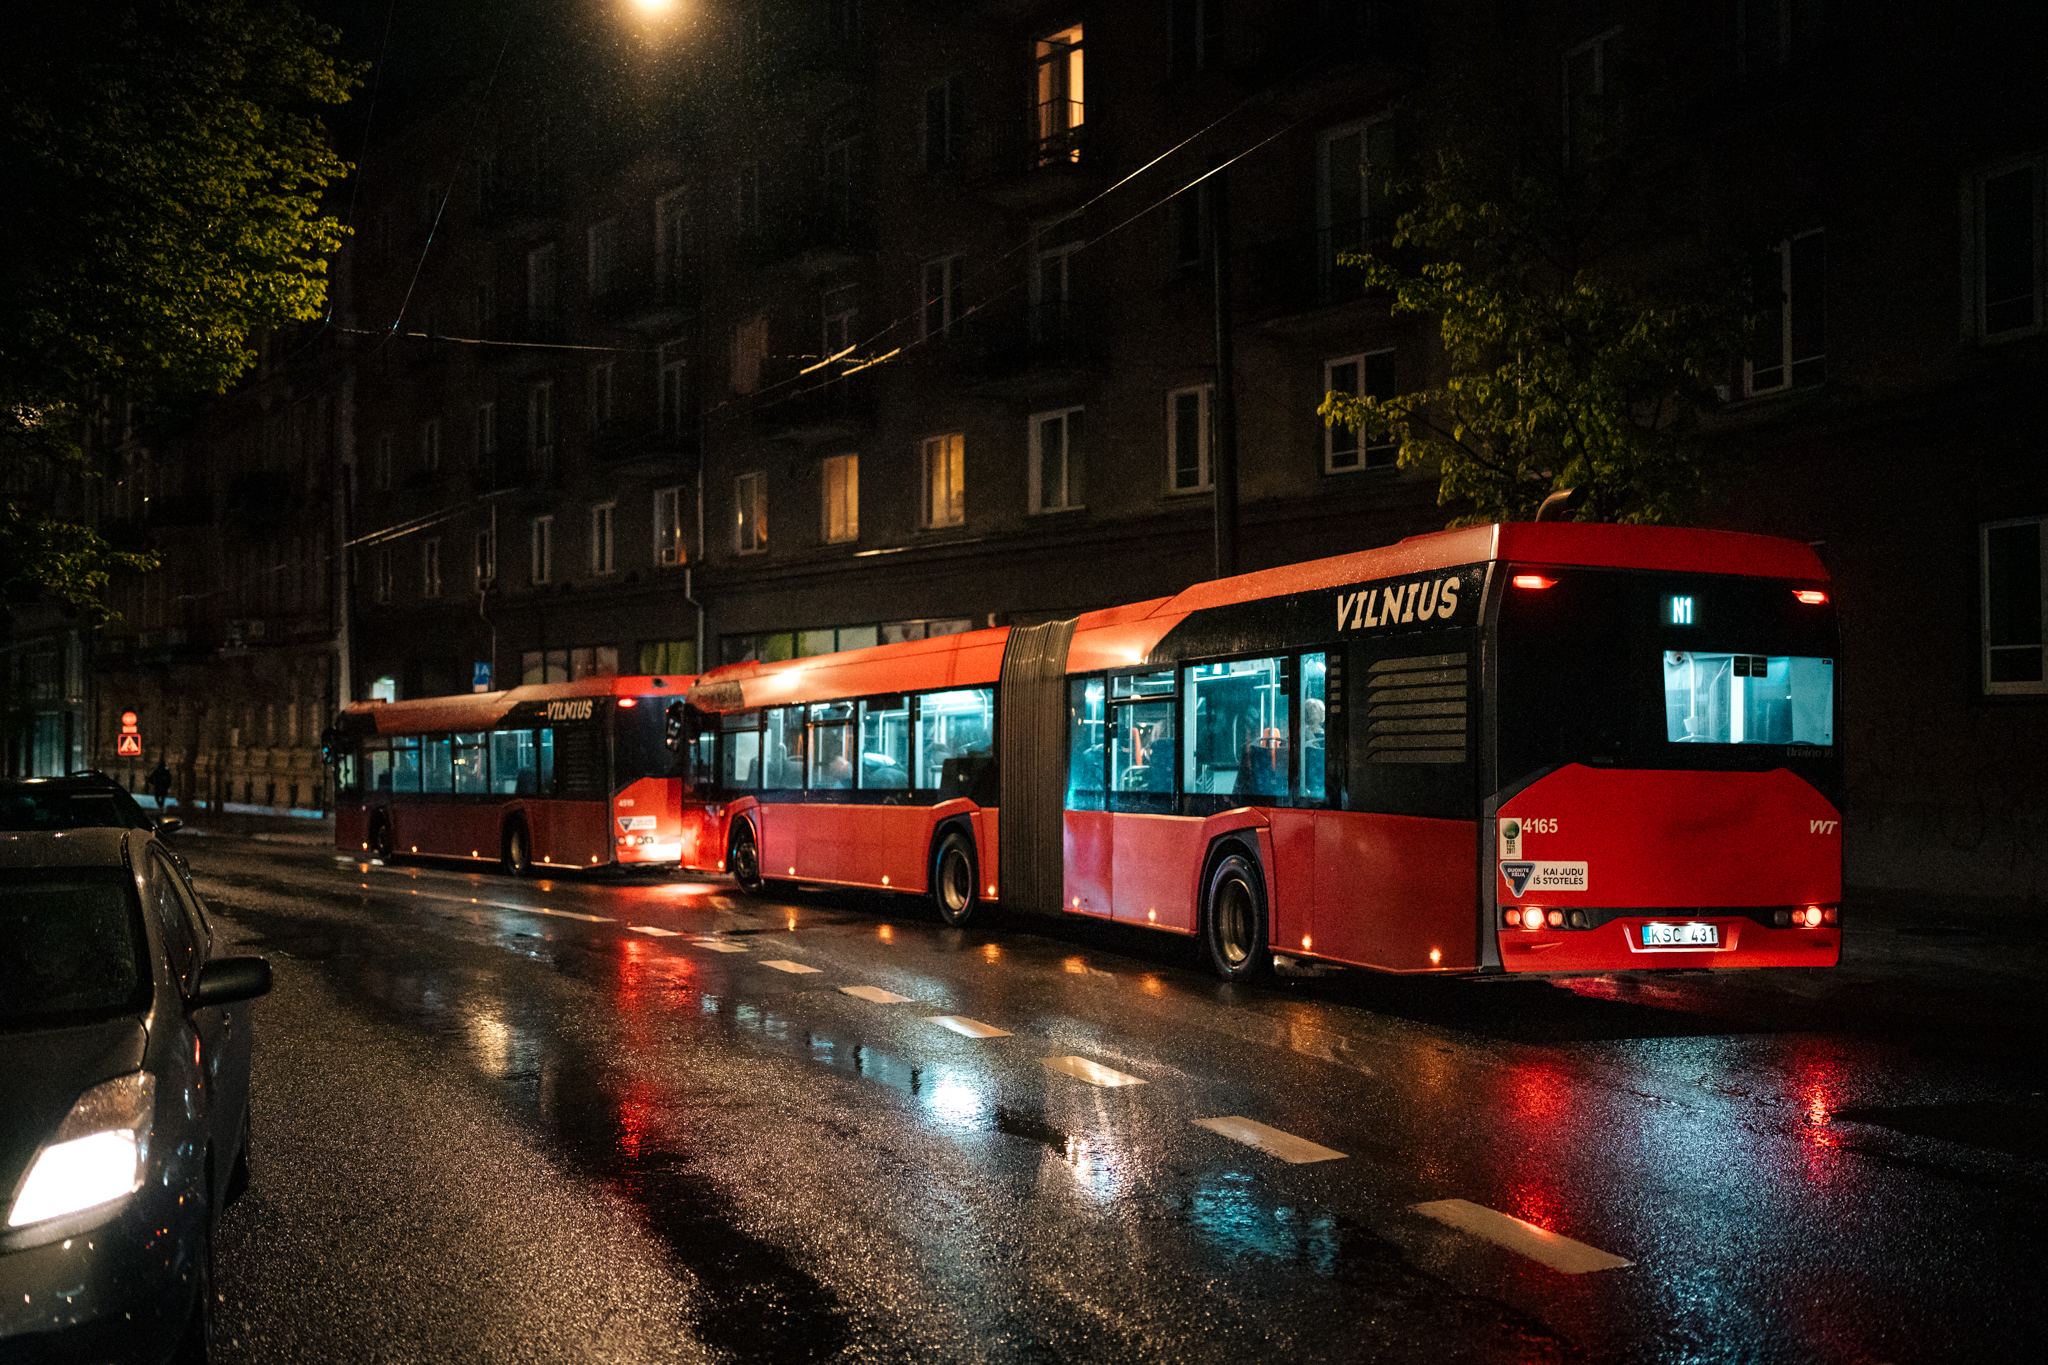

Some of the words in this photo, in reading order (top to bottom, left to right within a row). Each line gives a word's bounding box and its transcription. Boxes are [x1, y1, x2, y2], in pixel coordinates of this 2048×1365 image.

[1336, 576, 1460, 632] VILNIUS
[1672, 596, 1694, 624] N1
[548, 699, 593, 720] VILNIUS
[1522, 818, 1558, 833] 4165
[1810, 819, 1839, 835] VVT
[1533, 875, 1541, 885] IŠ
[1542, 875, 1584, 885] STOTELĖS
[1543, 868, 1558, 876] KAI
[1559, 868, 1584, 876] JUDU
[1651, 927, 1681, 943] KSC
[1691, 927, 1715, 943] 431
